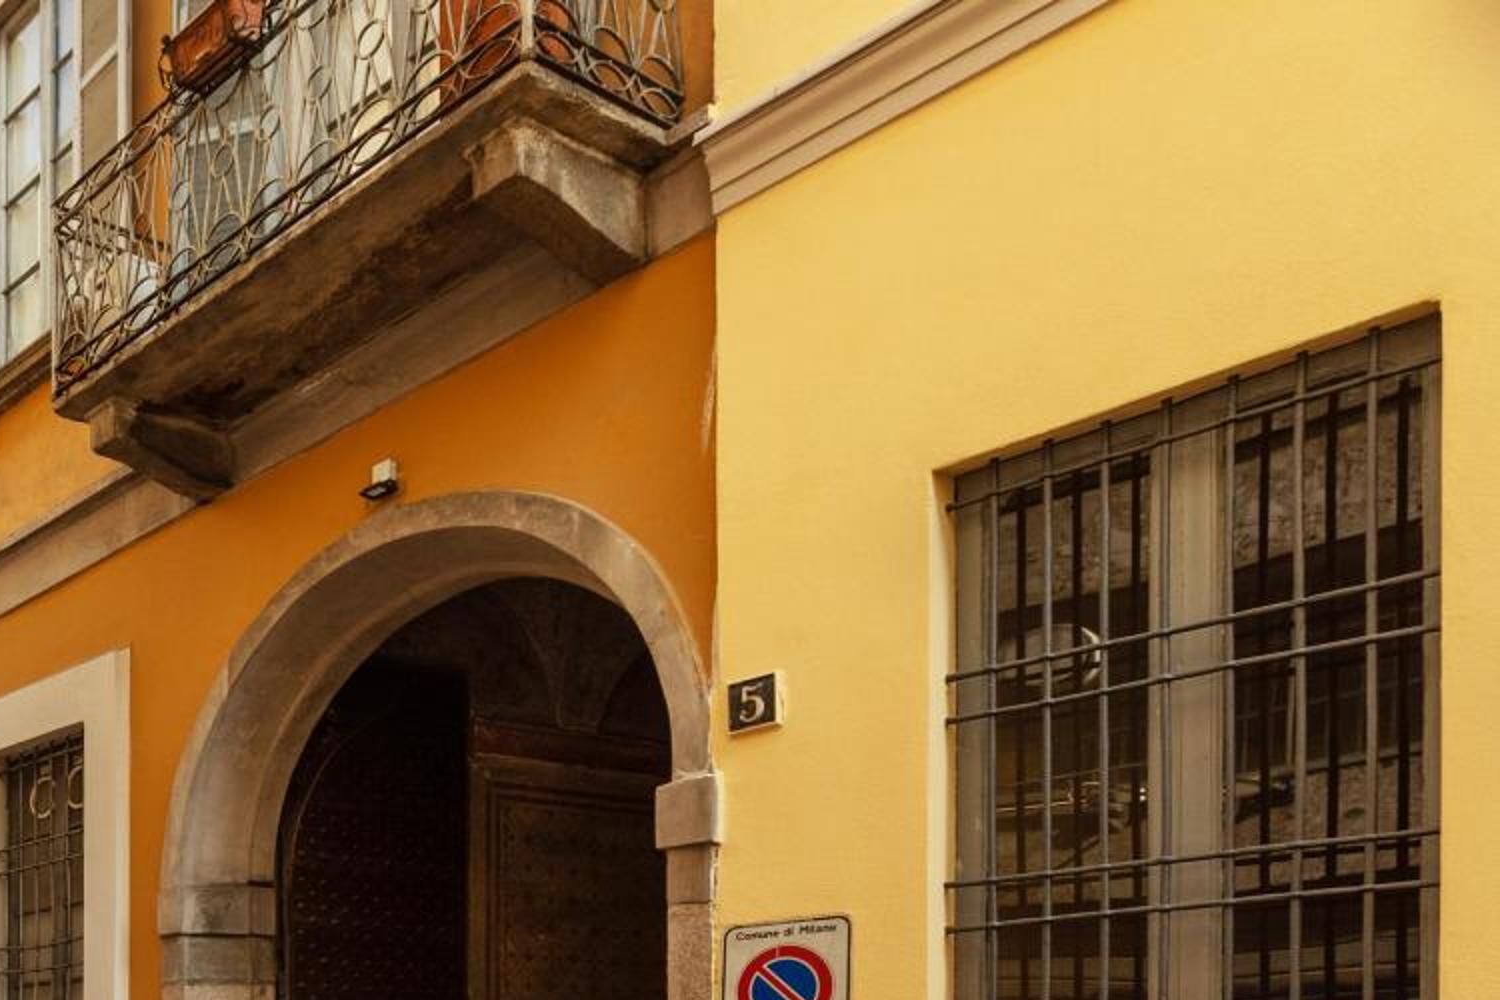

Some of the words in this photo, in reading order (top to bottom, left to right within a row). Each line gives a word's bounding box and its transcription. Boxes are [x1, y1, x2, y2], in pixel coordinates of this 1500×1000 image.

[739, 682, 765, 722] 5
[783, 928, 794, 936] di
[799, 925, 838, 934] Milano
